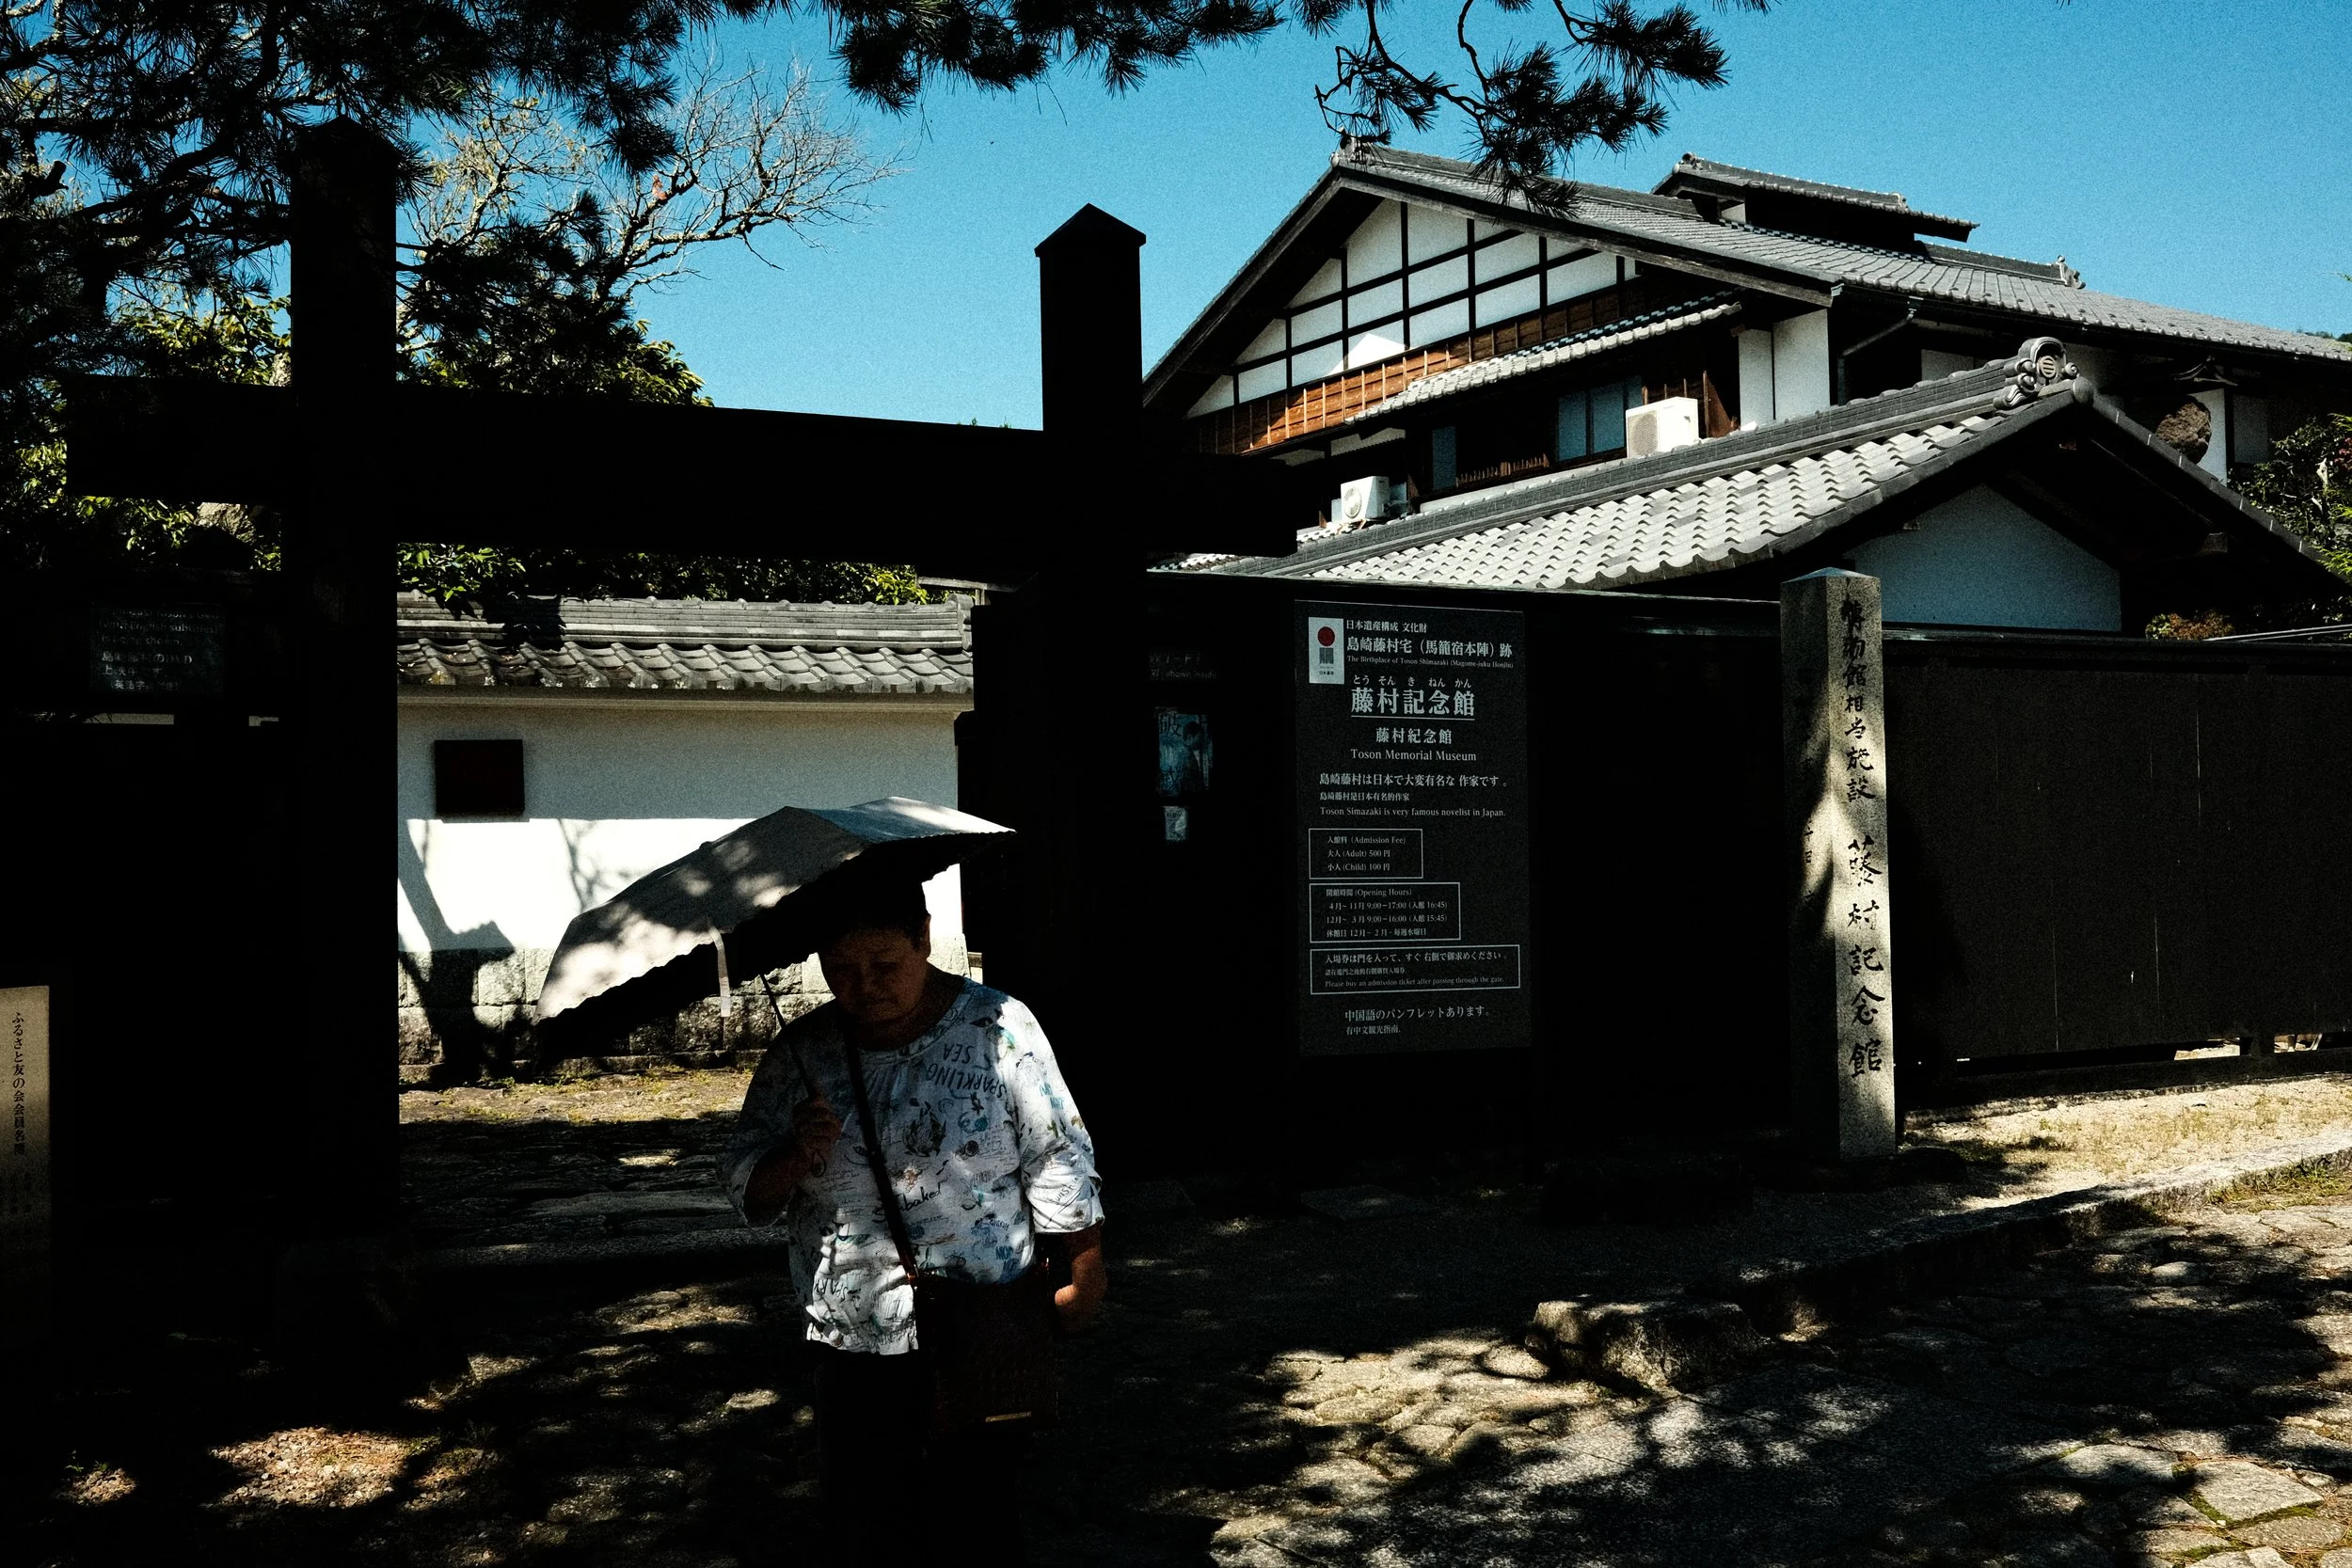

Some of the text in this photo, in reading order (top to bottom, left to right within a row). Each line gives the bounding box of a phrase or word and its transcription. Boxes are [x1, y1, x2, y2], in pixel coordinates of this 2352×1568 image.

[1346, 620, 1427, 633] 日本遺産構成 文化財
[1360, 656, 1391, 665] Birthplace
[1419, 657, 1449, 666] Shimazaki
[1407, 677, 1415, 686] き
[1351, 687, 1475, 717] 藤村記念館
[1376, 727, 1453, 745] 藤村紀念館
[1351, 749, 1477, 761] Toson Memorial Museum
[1319, 773, 1507, 787] 島崎藤村は日本で大変有名な 作家です。
[1319, 791, 1410, 801] 島崎藤村是日本有名的作家
[1320, 806, 1506, 819] Toson Simazaki is very famous novelist in Japan.
[1351, 835, 1390, 845] (Admission
[1391, 836, 1406, 845] Fee)
[1327, 849, 1391, 858] 大人 (Adult) 500 円
[1327, 863, 1342, 871] 小人
[1343, 863, 1367, 872] (Child)
[1355, 888, 1387, 897] (Opening
[1389, 888, 1412, 896] Hours)
[1426, 900, 1448, 909] 16:45)
[1848, 835, 1885, 1079] 藤村記念館
[1345, 980, 1358, 989] buy
[1432, 978, 1454, 987] passing
[1455, 977, 1479, 986] through
[1490, 976, 1505, 985] gate.
[1344, 1006, 1490, 1022] 中国語のパンフレットあります。
[943, 1043, 975, 1064] SEA
[926, 1063, 1008, 1099] SPARKLING
